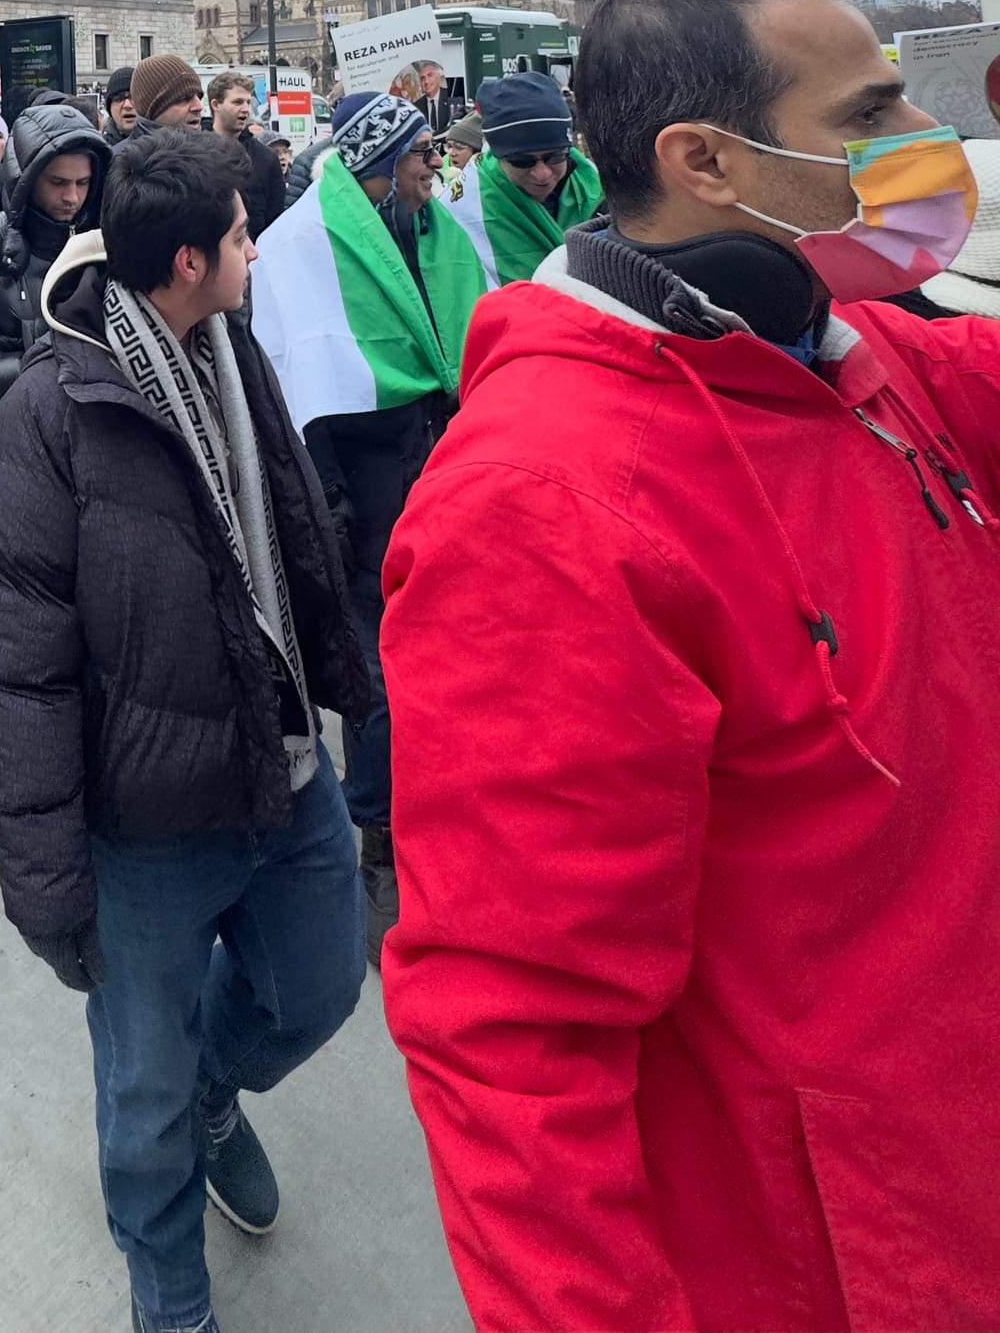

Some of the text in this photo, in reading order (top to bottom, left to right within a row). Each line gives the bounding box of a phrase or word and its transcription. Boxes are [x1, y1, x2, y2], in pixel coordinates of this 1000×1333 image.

[344, 45, 377, 61] REZA
[380, 31, 432, 52] PAHLAVI
[913, 41, 978, 52] democracy
